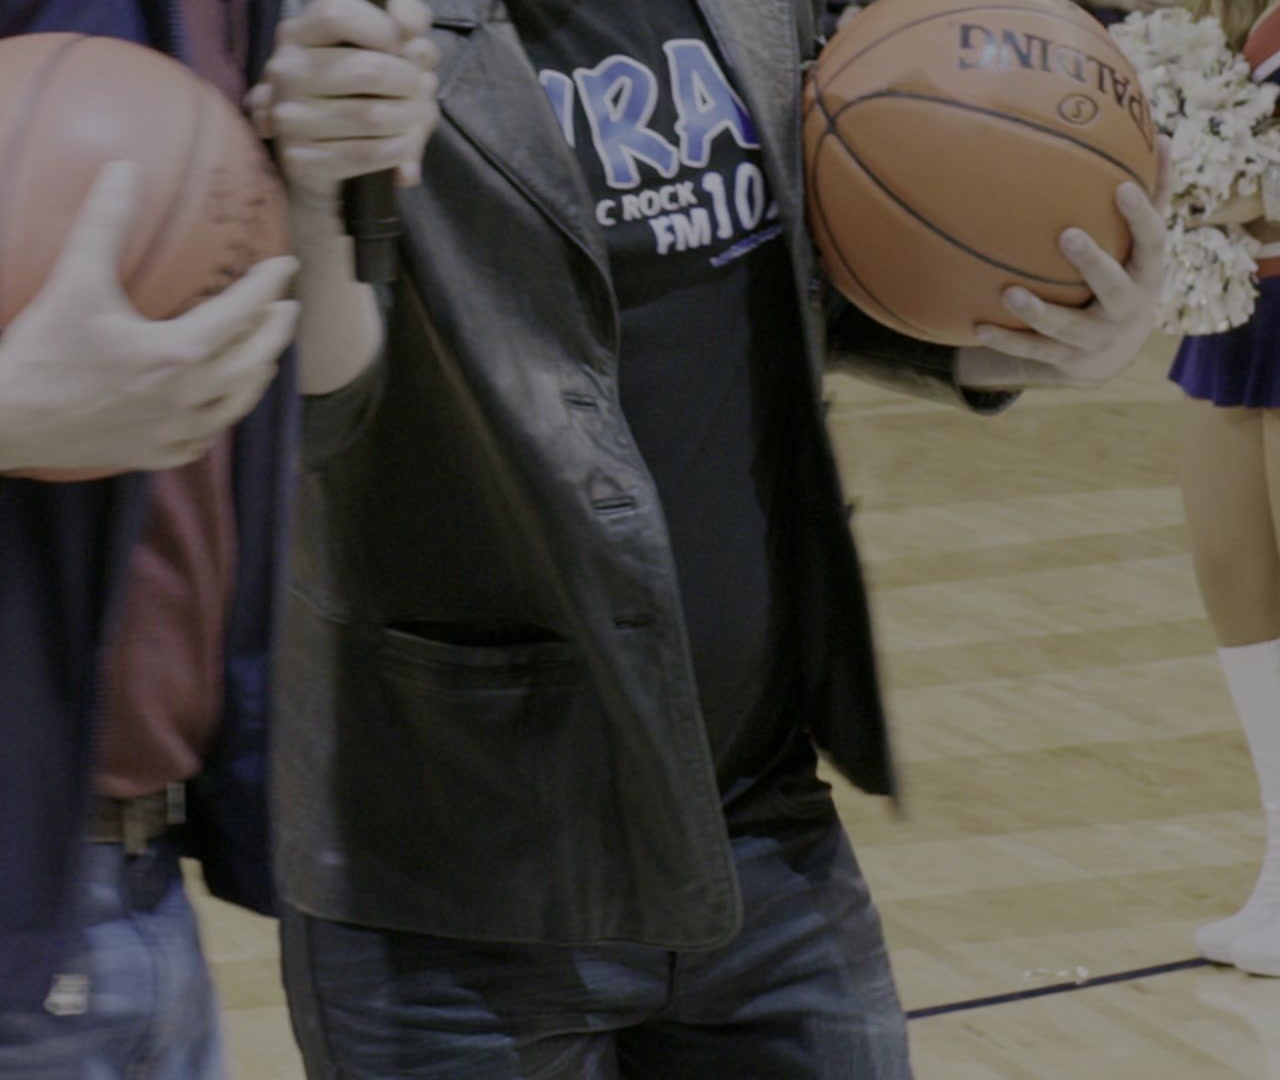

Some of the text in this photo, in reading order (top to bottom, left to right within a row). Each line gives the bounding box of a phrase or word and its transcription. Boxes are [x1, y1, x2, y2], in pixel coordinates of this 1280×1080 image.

[957, 23, 1154, 153] PALDING
[621, 179, 698, 222] ROCK
[648, 160, 780, 256] FM 10
